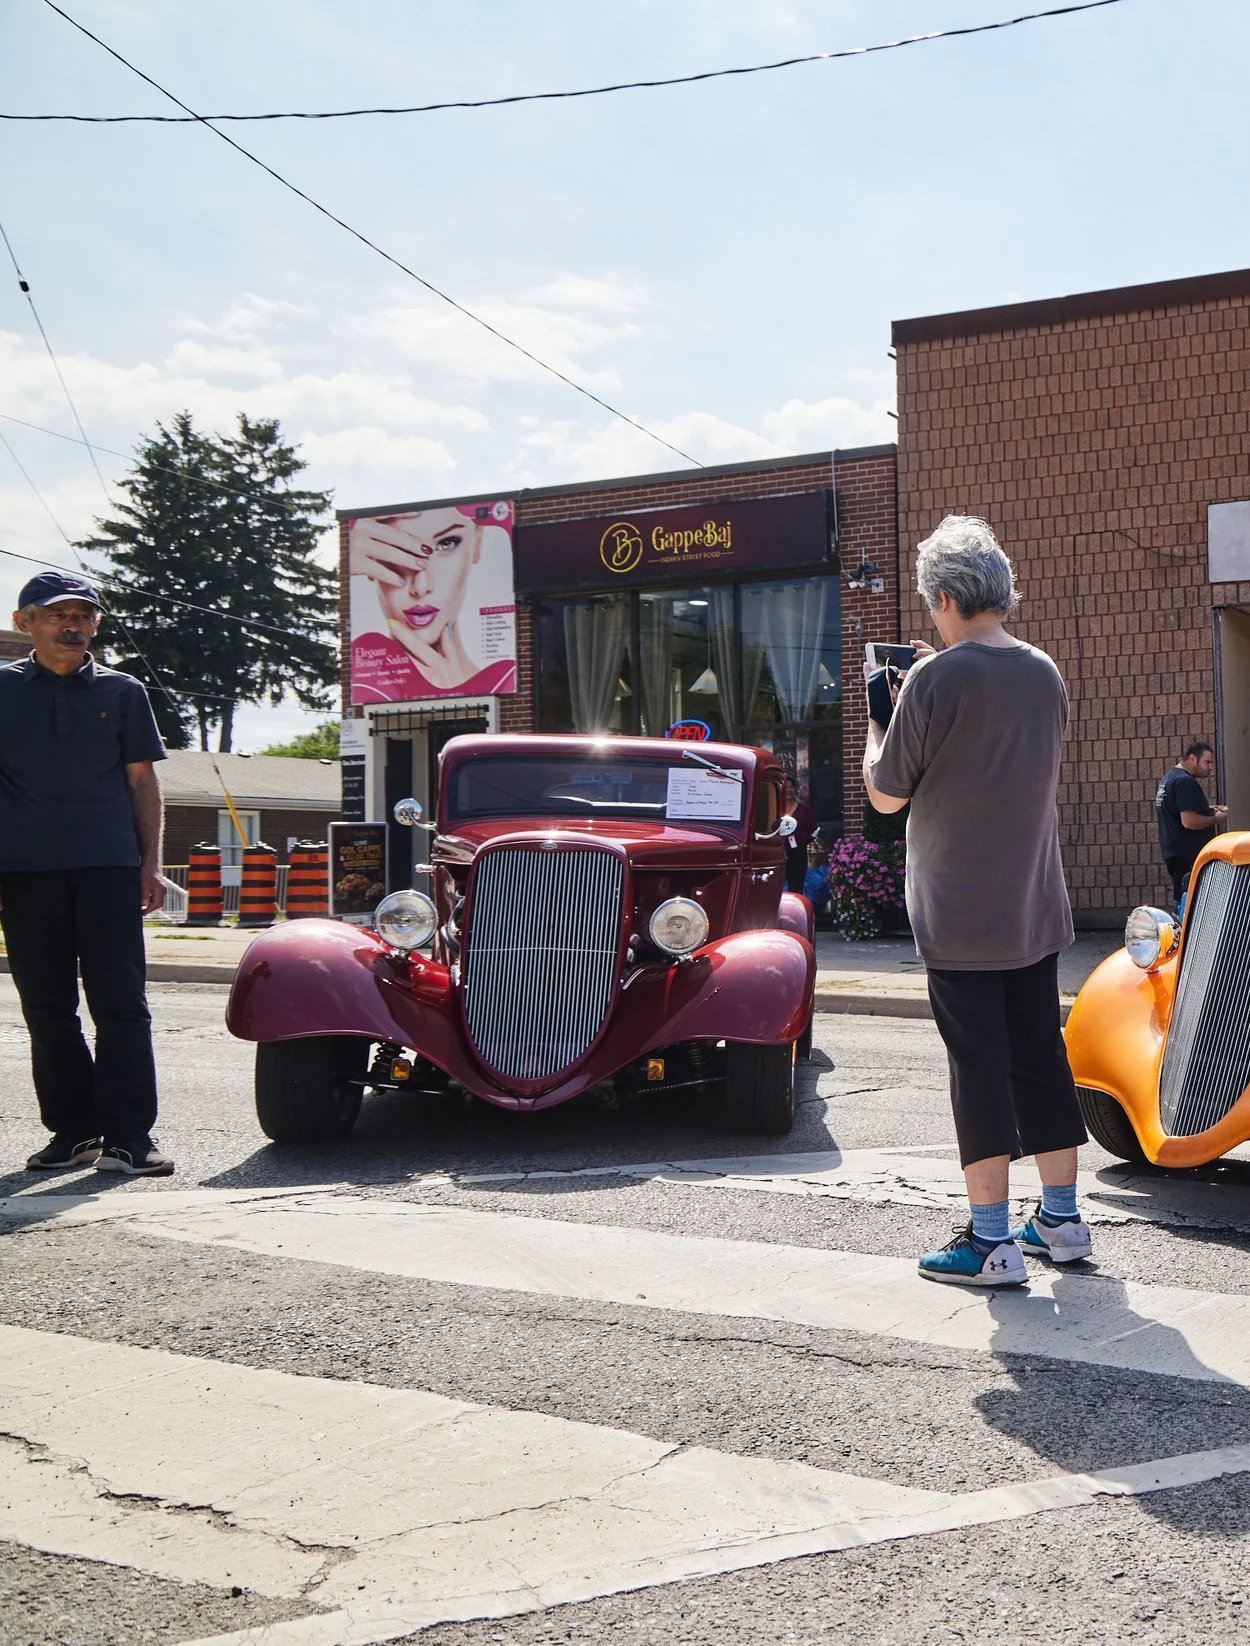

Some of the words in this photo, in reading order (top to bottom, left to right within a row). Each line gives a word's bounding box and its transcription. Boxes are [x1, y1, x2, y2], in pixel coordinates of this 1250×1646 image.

[651, 520, 732, 554] GappeBaj
[661, 555, 681, 563] INDIAN
[682, 553, 702, 561] STREET
[703, 552, 721, 560] FOOD
[355, 647, 386, 659] Elegant
[355, 657, 384, 669] Beauty
[385, 654, 410, 666] Salon
[669, 725, 706, 741] OPEN
